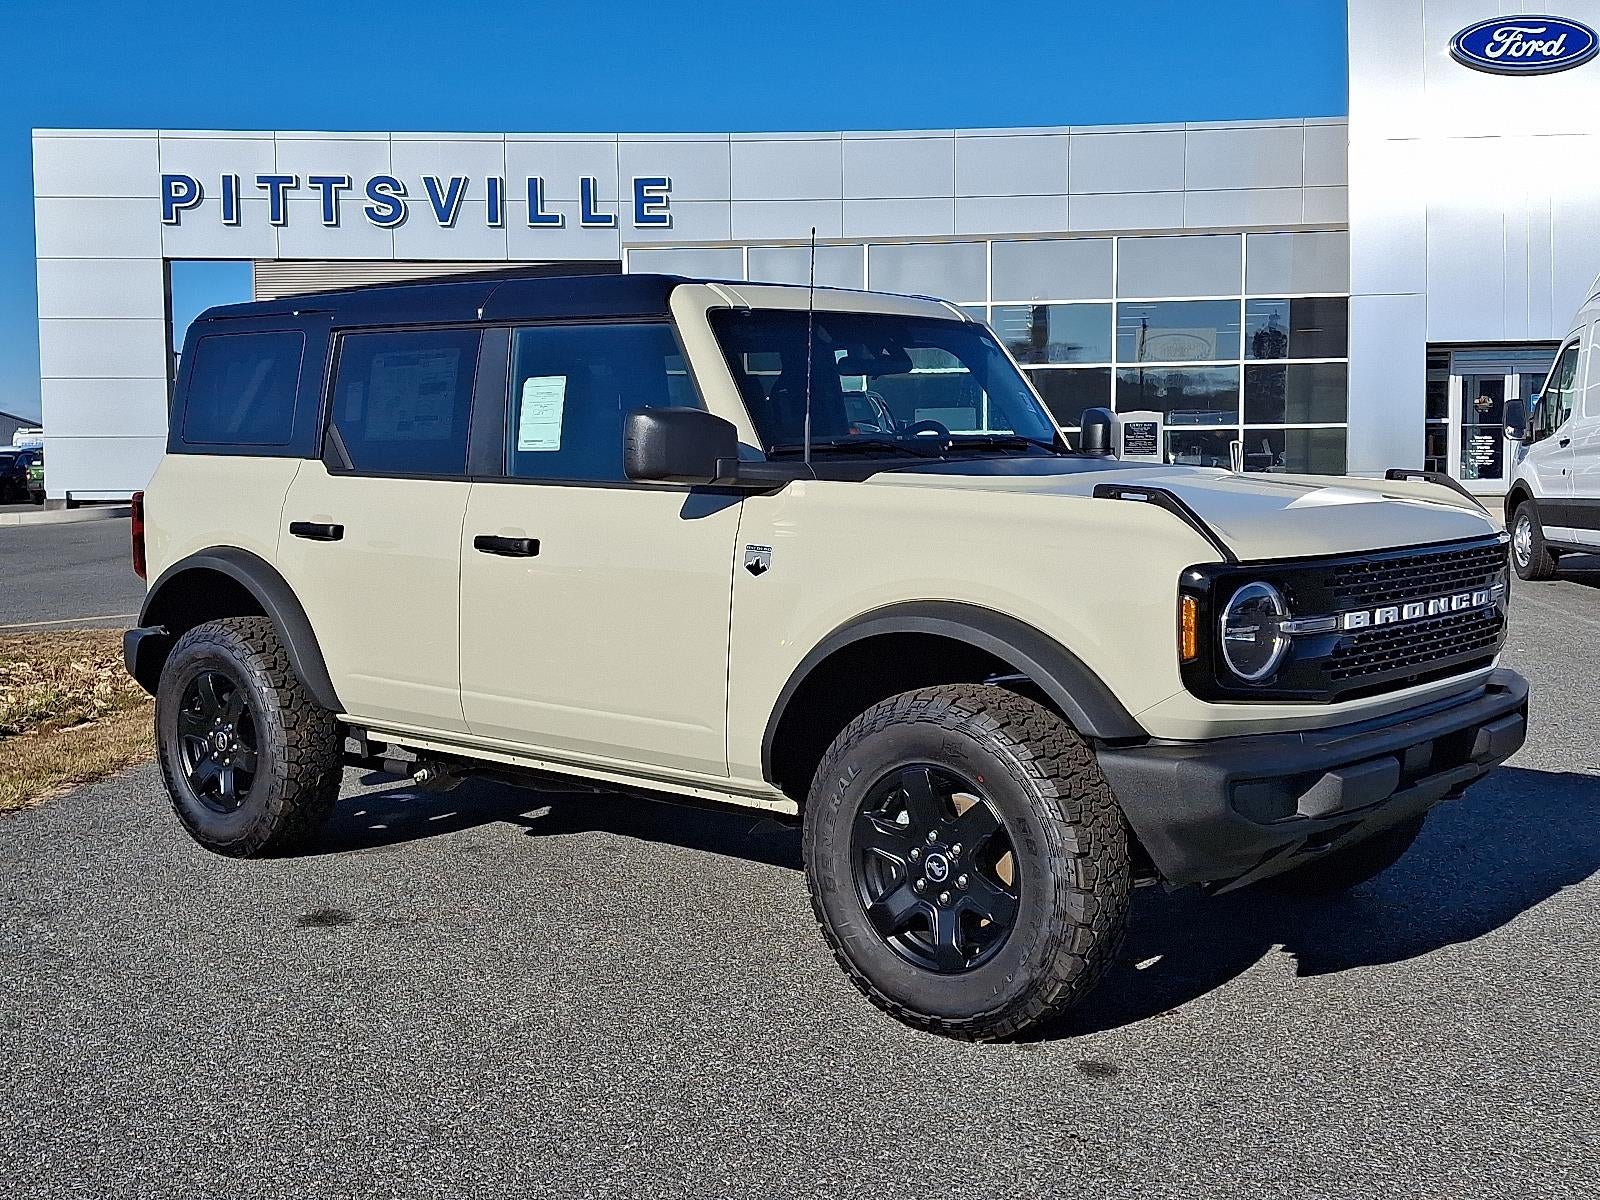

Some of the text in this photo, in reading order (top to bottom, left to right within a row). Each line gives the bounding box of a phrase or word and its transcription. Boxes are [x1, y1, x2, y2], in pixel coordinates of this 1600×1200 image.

[1484, 26, 1568, 58] Ford
[160, 174, 674, 230] PITTSVILLE
[1343, 589, 1490, 630] BRONCO
